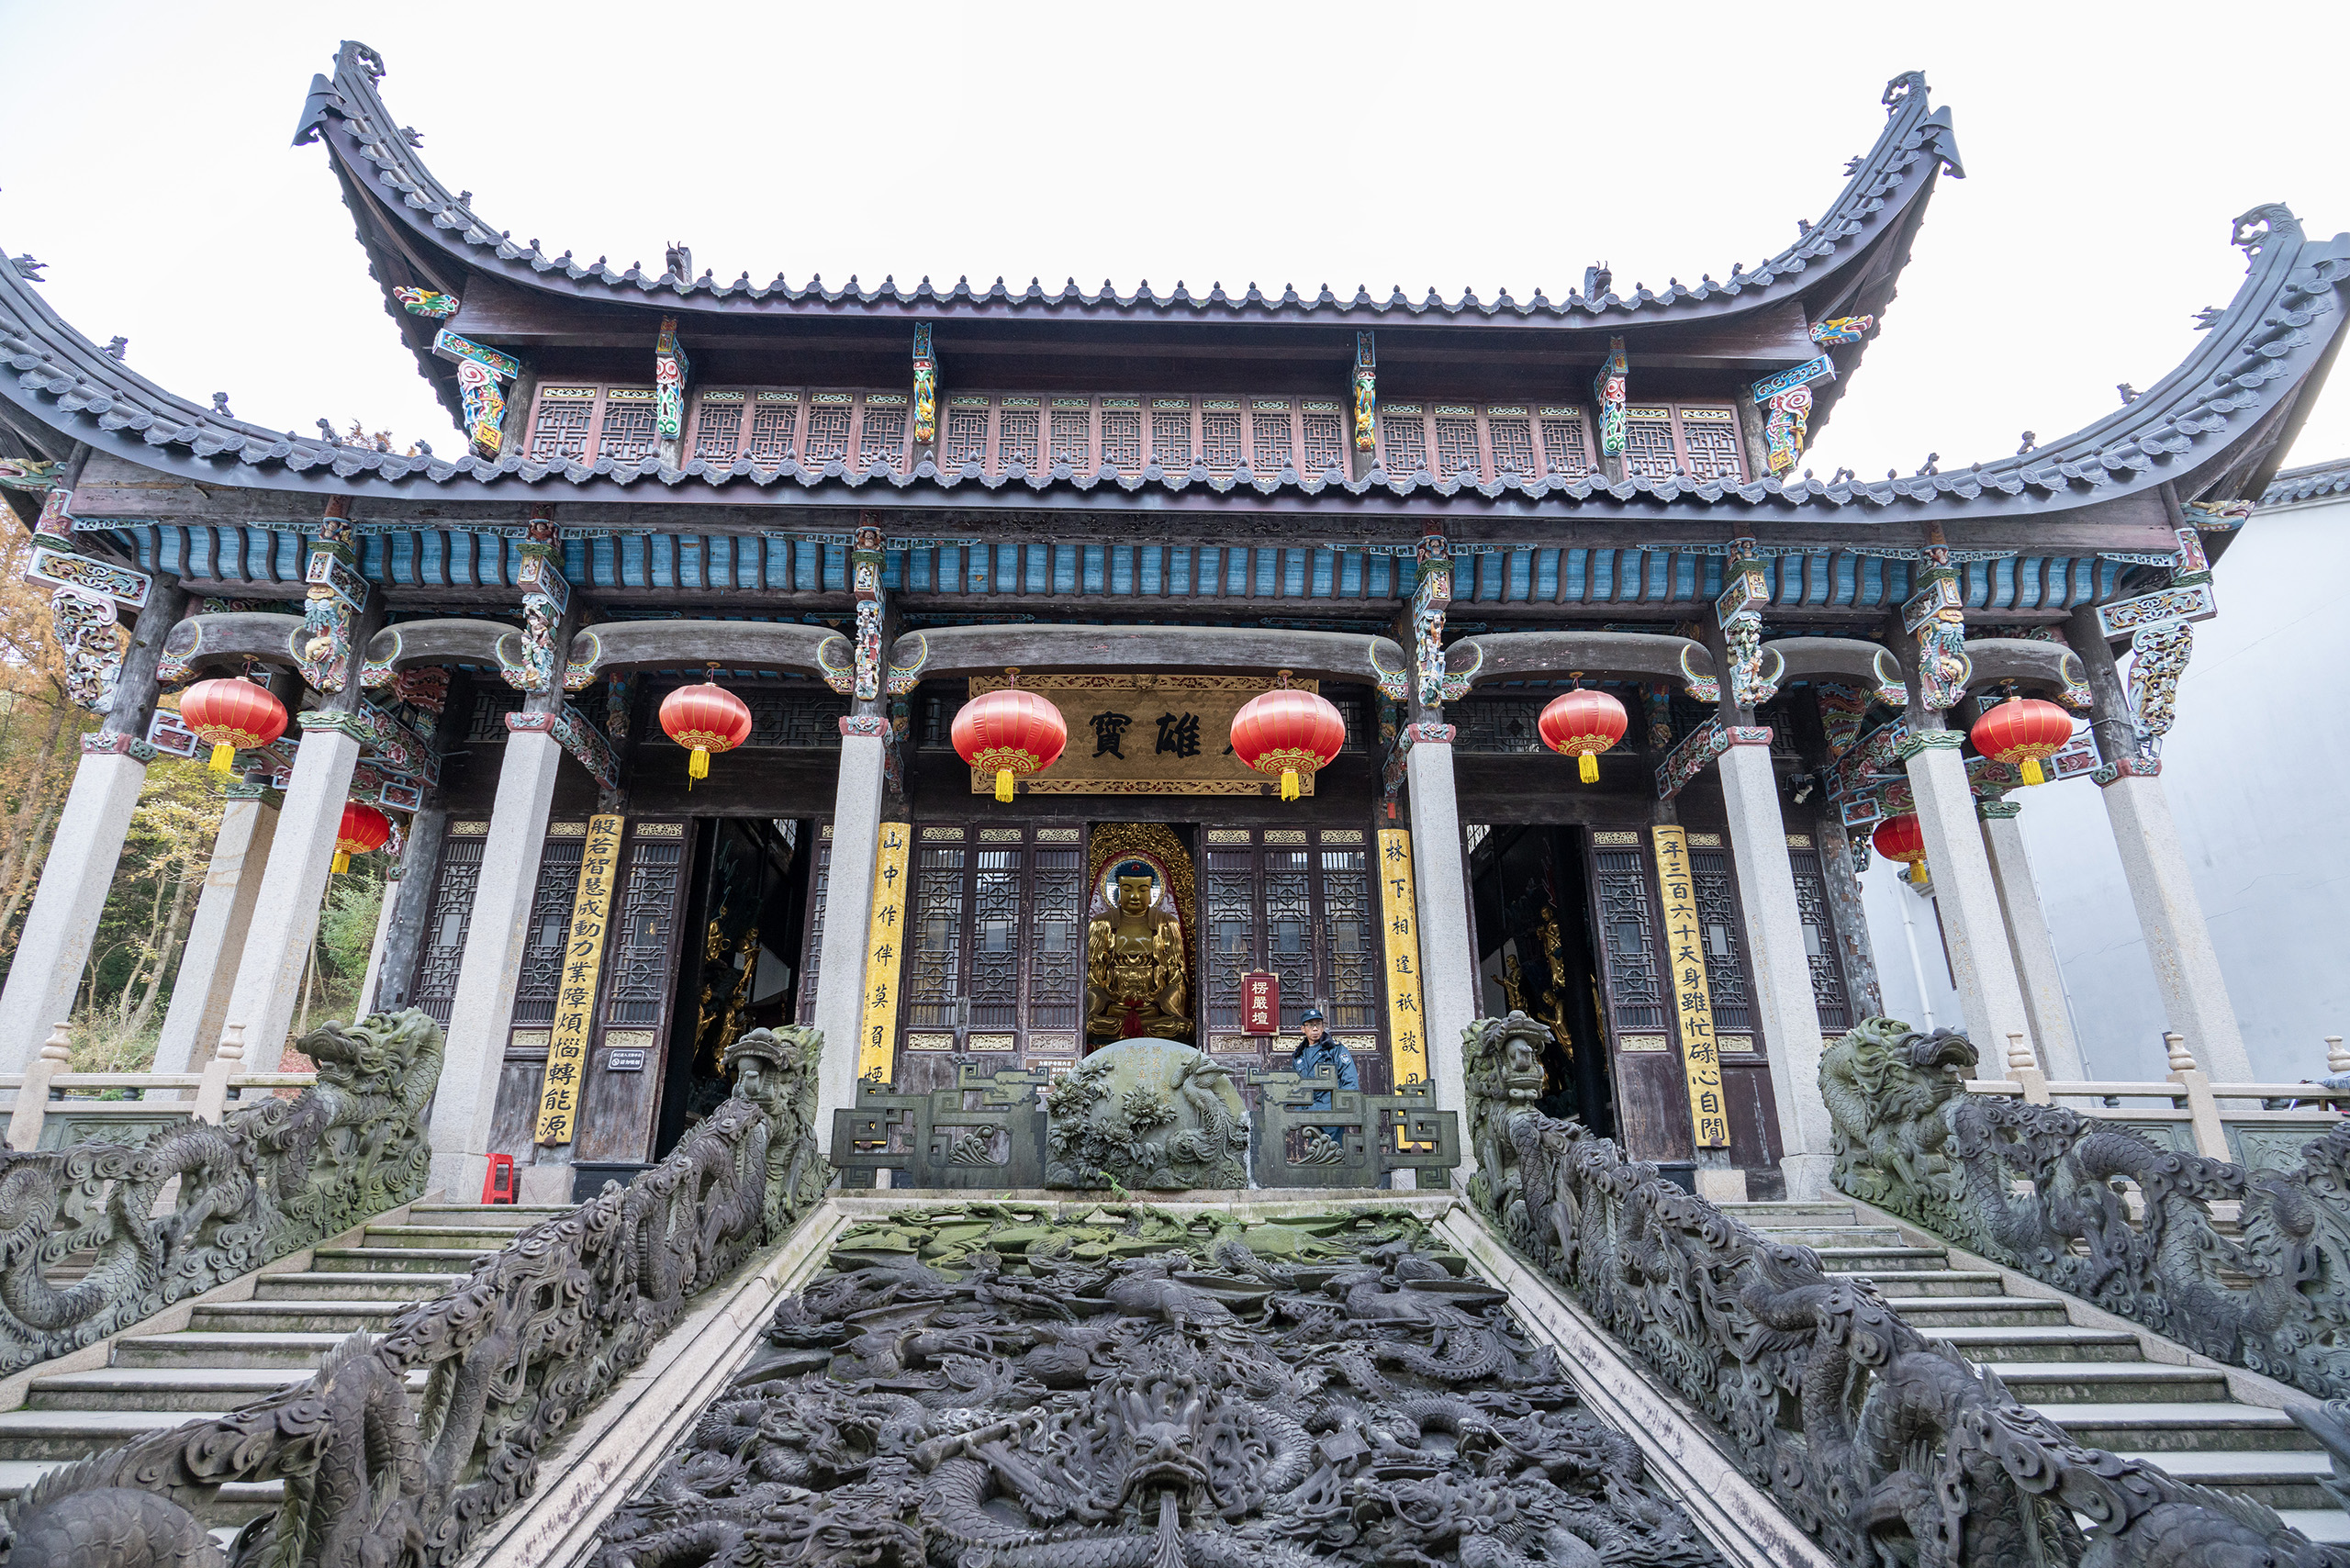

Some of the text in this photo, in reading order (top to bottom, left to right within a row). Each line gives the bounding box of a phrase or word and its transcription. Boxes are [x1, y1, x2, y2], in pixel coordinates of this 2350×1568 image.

[1058, 711, 1234, 761] 雄寶
[539, 818, 618, 1137] 般若智慧成動力業障煩惱轉能源
[1251, 981, 1269, 1025] 楞嚴壇
